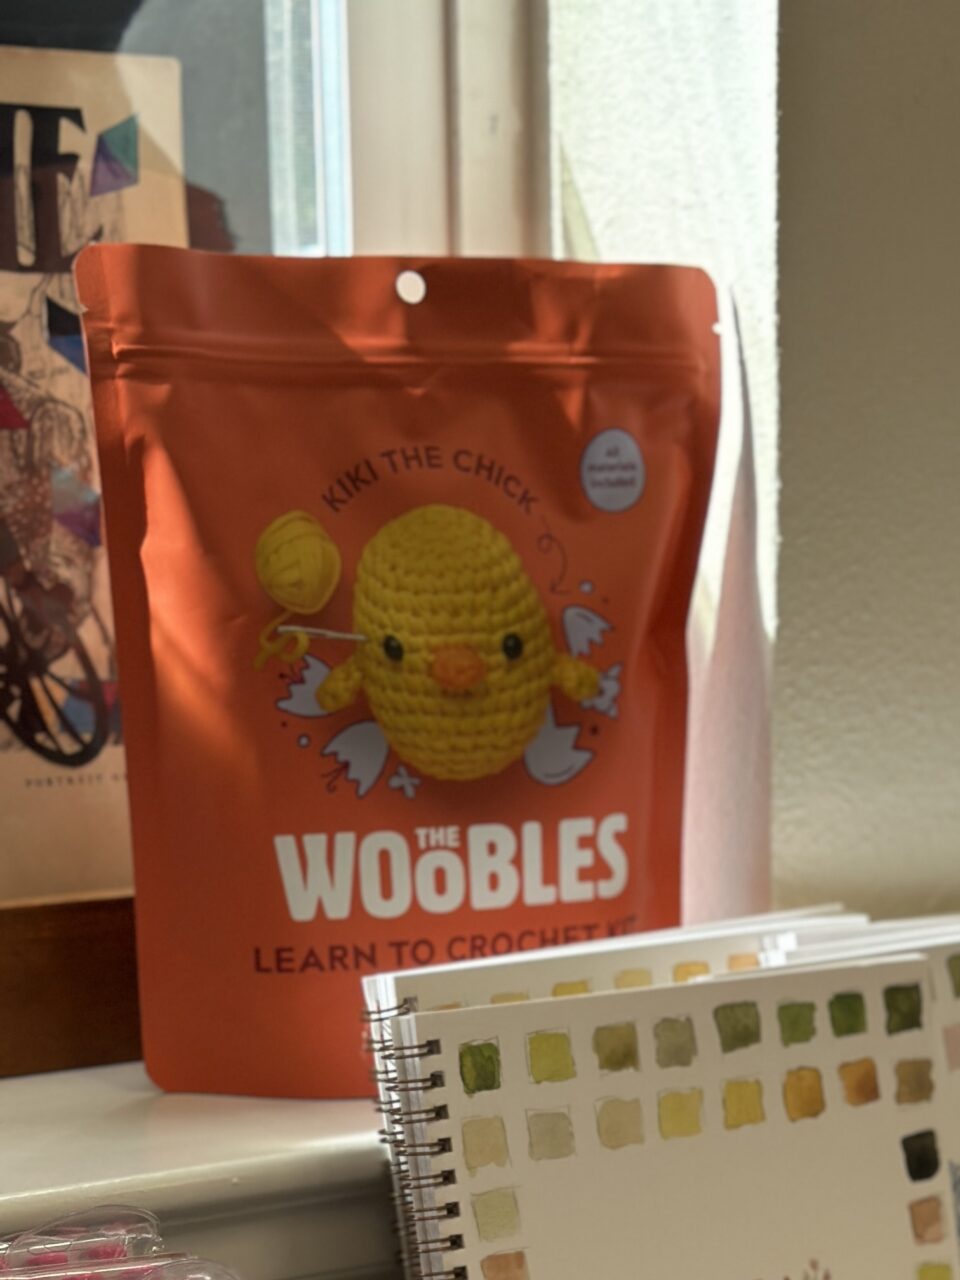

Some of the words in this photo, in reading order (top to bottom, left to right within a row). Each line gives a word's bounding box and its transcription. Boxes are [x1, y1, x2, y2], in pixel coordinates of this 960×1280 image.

[322, 458, 380, 513] KIKI
[380, 446, 443, 474] THE
[453, 449, 539, 515] CHICK
[274, 812, 629, 922] WOOBLES
[415, 826, 460, 849] THE
[254, 943, 377, 974] LEARN
[389, 940, 435, 966] TO
[447, 923, 597, 962] CROCHET
